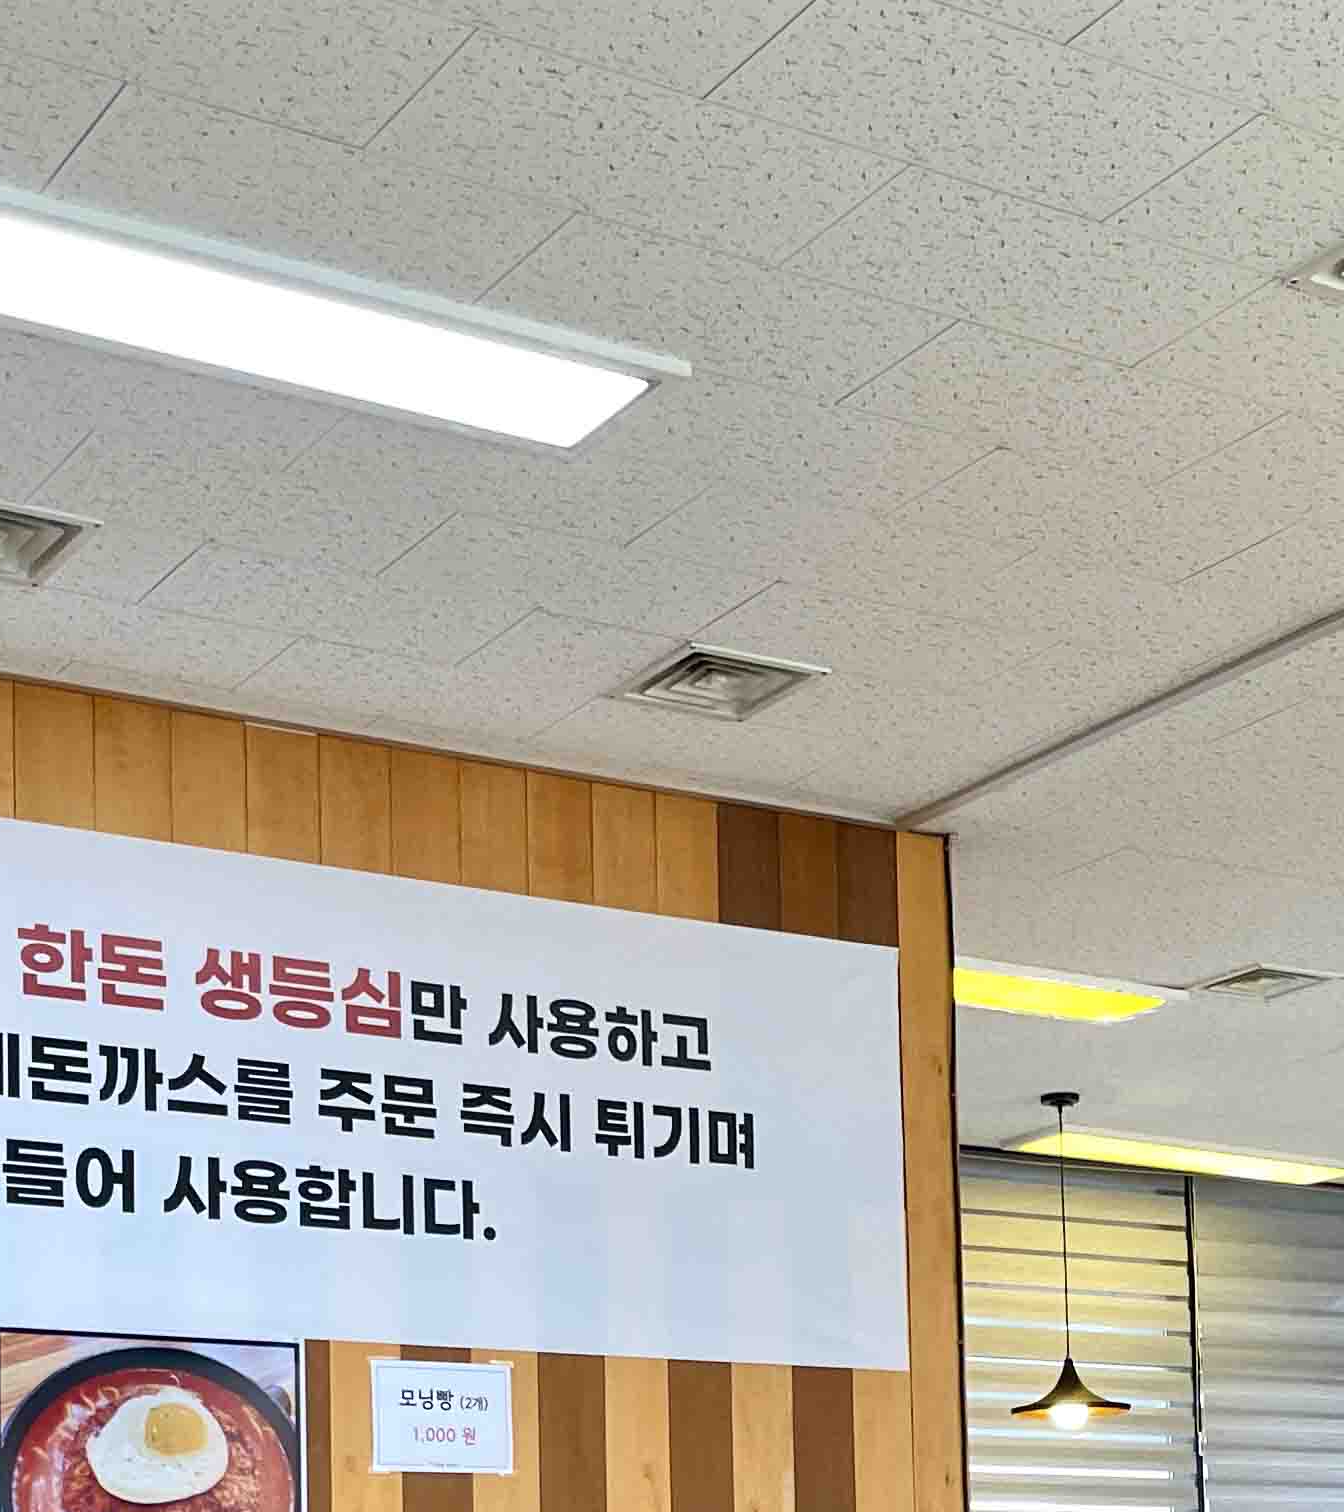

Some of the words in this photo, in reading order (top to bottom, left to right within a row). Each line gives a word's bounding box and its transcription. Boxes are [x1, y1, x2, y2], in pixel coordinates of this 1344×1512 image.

[18, 924, 166, 1010] 한돈
[489, 993, 711, 1071] 사용하고
[318, 1068, 437, 1139] 주문
[460, 1083, 571, 1152] 즉시
[595, 1099, 754, 1169] 튀기며
[164, 1156, 496, 1240] 사용합니다.
[400, 1389, 454, 1411] 모닝빵
[459, 1396, 489, 1411] (2개)
[462, 1427, 477, 1446] 원
